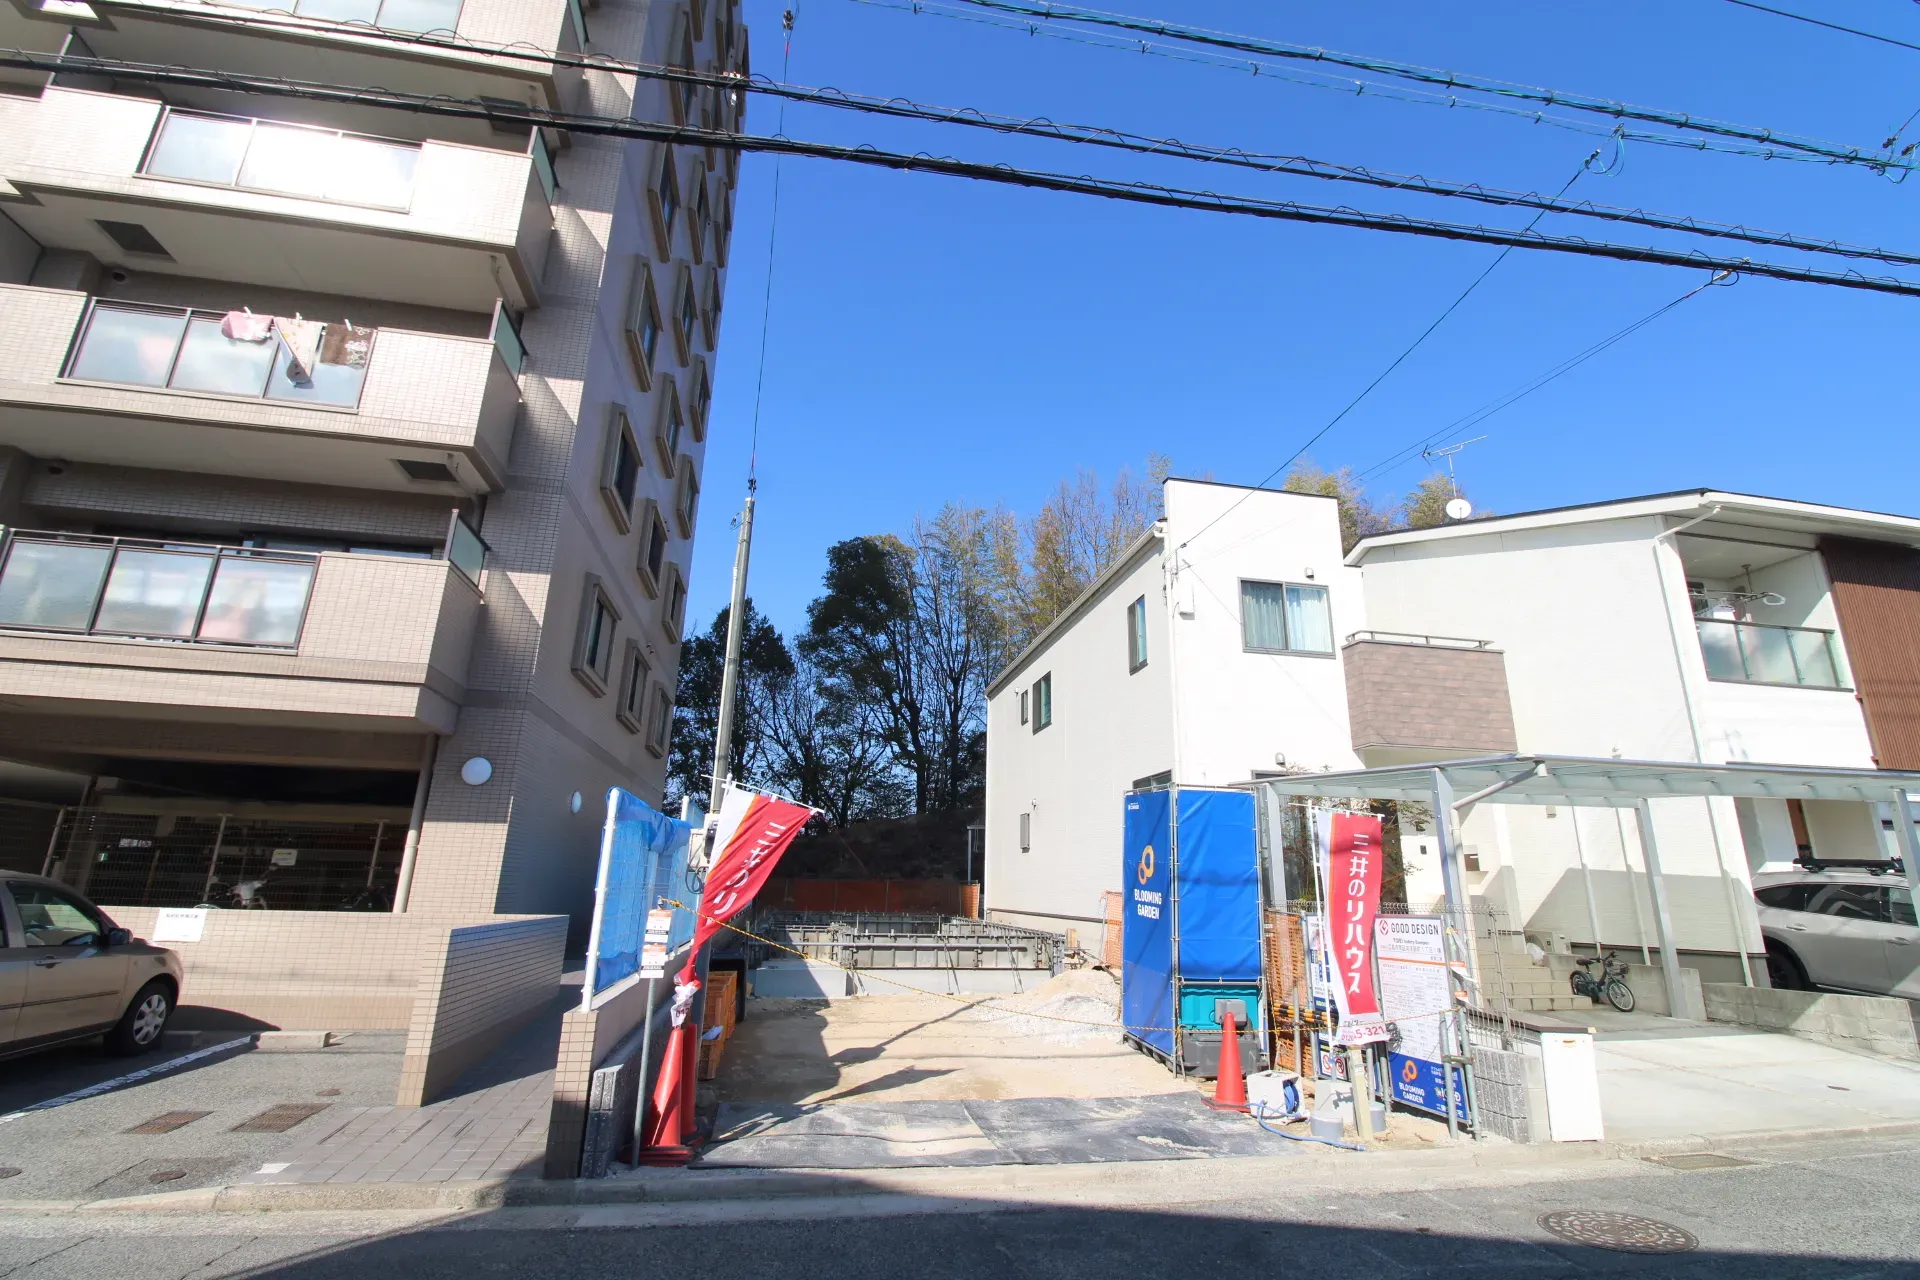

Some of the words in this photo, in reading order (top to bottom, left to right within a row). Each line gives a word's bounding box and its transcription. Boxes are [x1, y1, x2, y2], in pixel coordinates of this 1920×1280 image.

[1134, 888, 1162, 905] BLOOMING
[1137, 903, 1160, 920] GARDEN
[1345, 833, 1370, 995] 三井のリハウス
[1391, 923, 1409, 933] GOOD
[1411, 924, 1439, 935] DESIGN
[1398, 1082, 1426, 1097] BLOOMING
[1402, 1091, 1424, 1105] GARDEN
